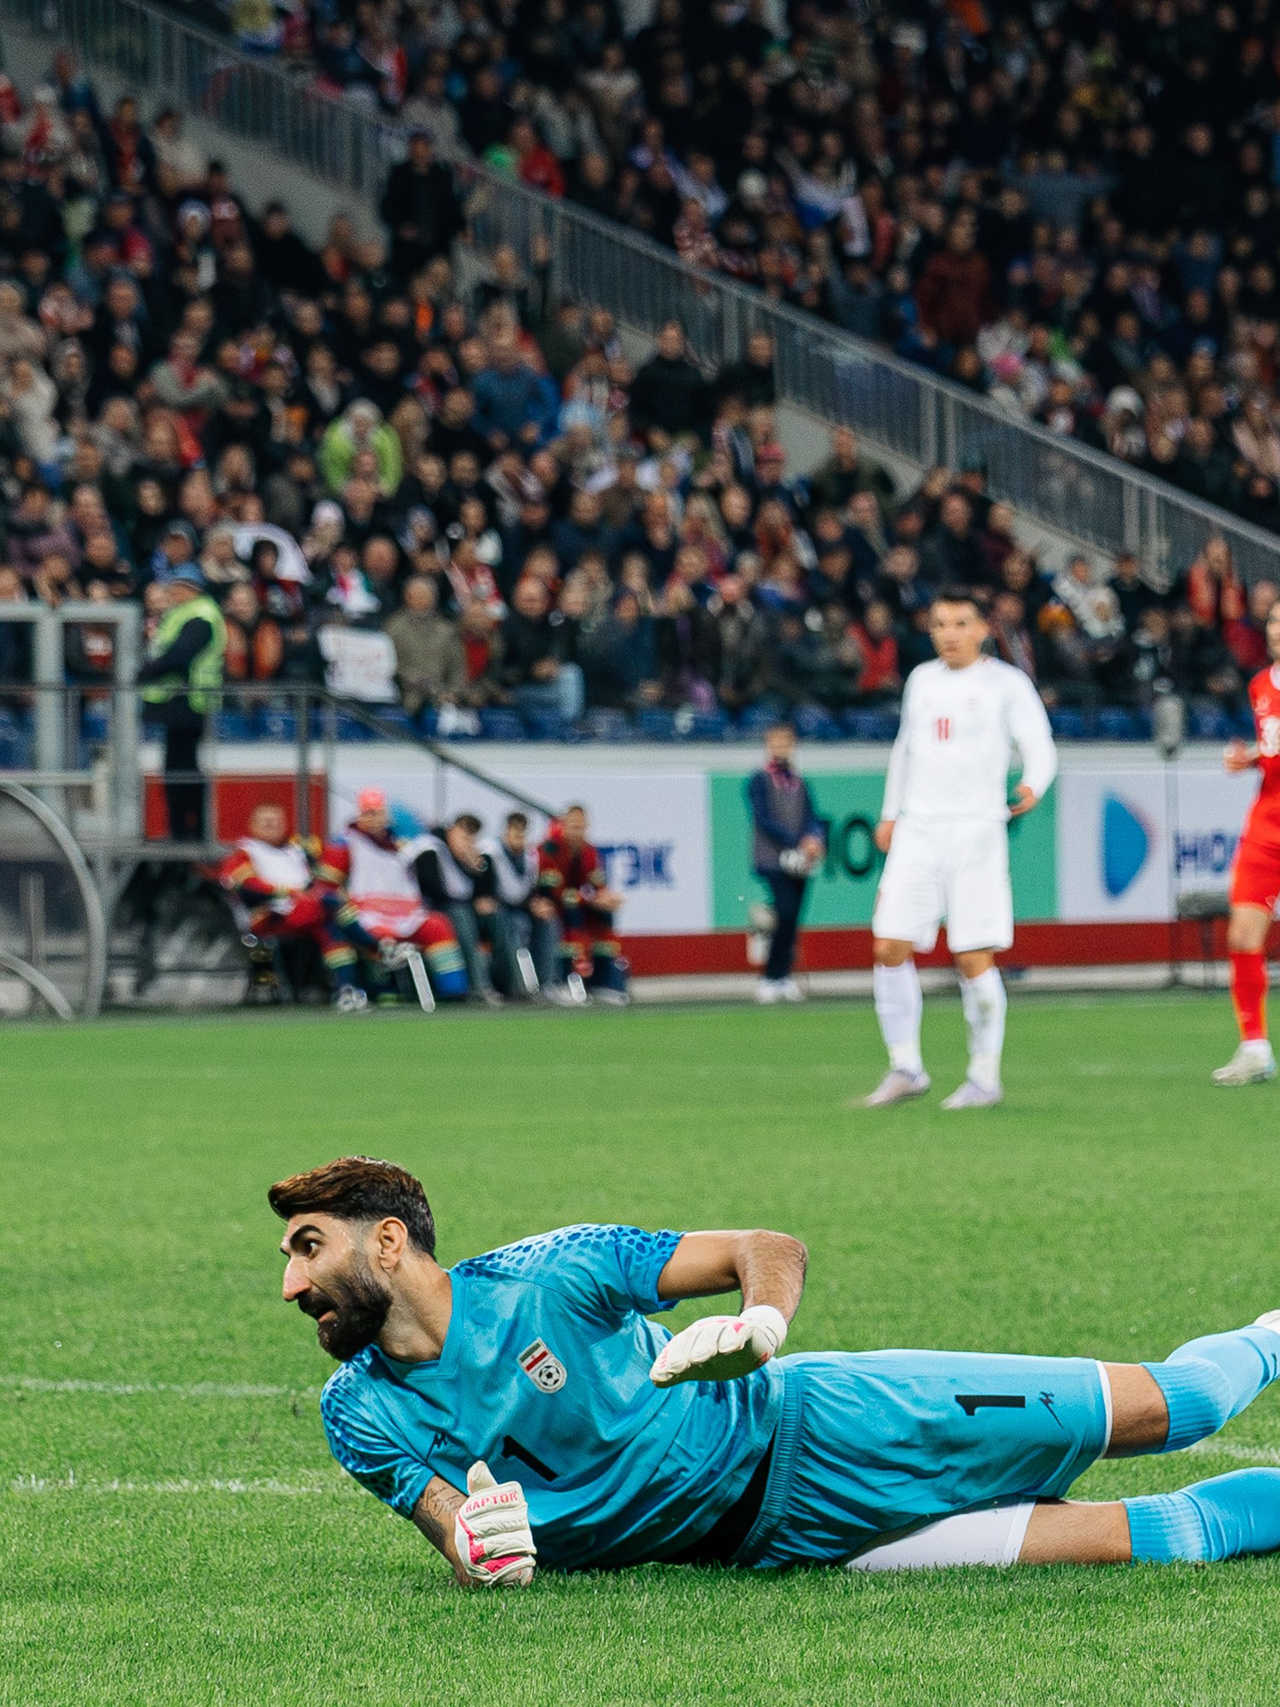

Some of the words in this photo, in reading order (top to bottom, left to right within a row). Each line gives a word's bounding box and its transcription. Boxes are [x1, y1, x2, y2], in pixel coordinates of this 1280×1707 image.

[932, 717, 951, 742] 11
[953, 1394, 1026, 1417] 1
[501, 1434, 560, 1483] 1
[465, 1490, 519, 1514] RAPTOR
